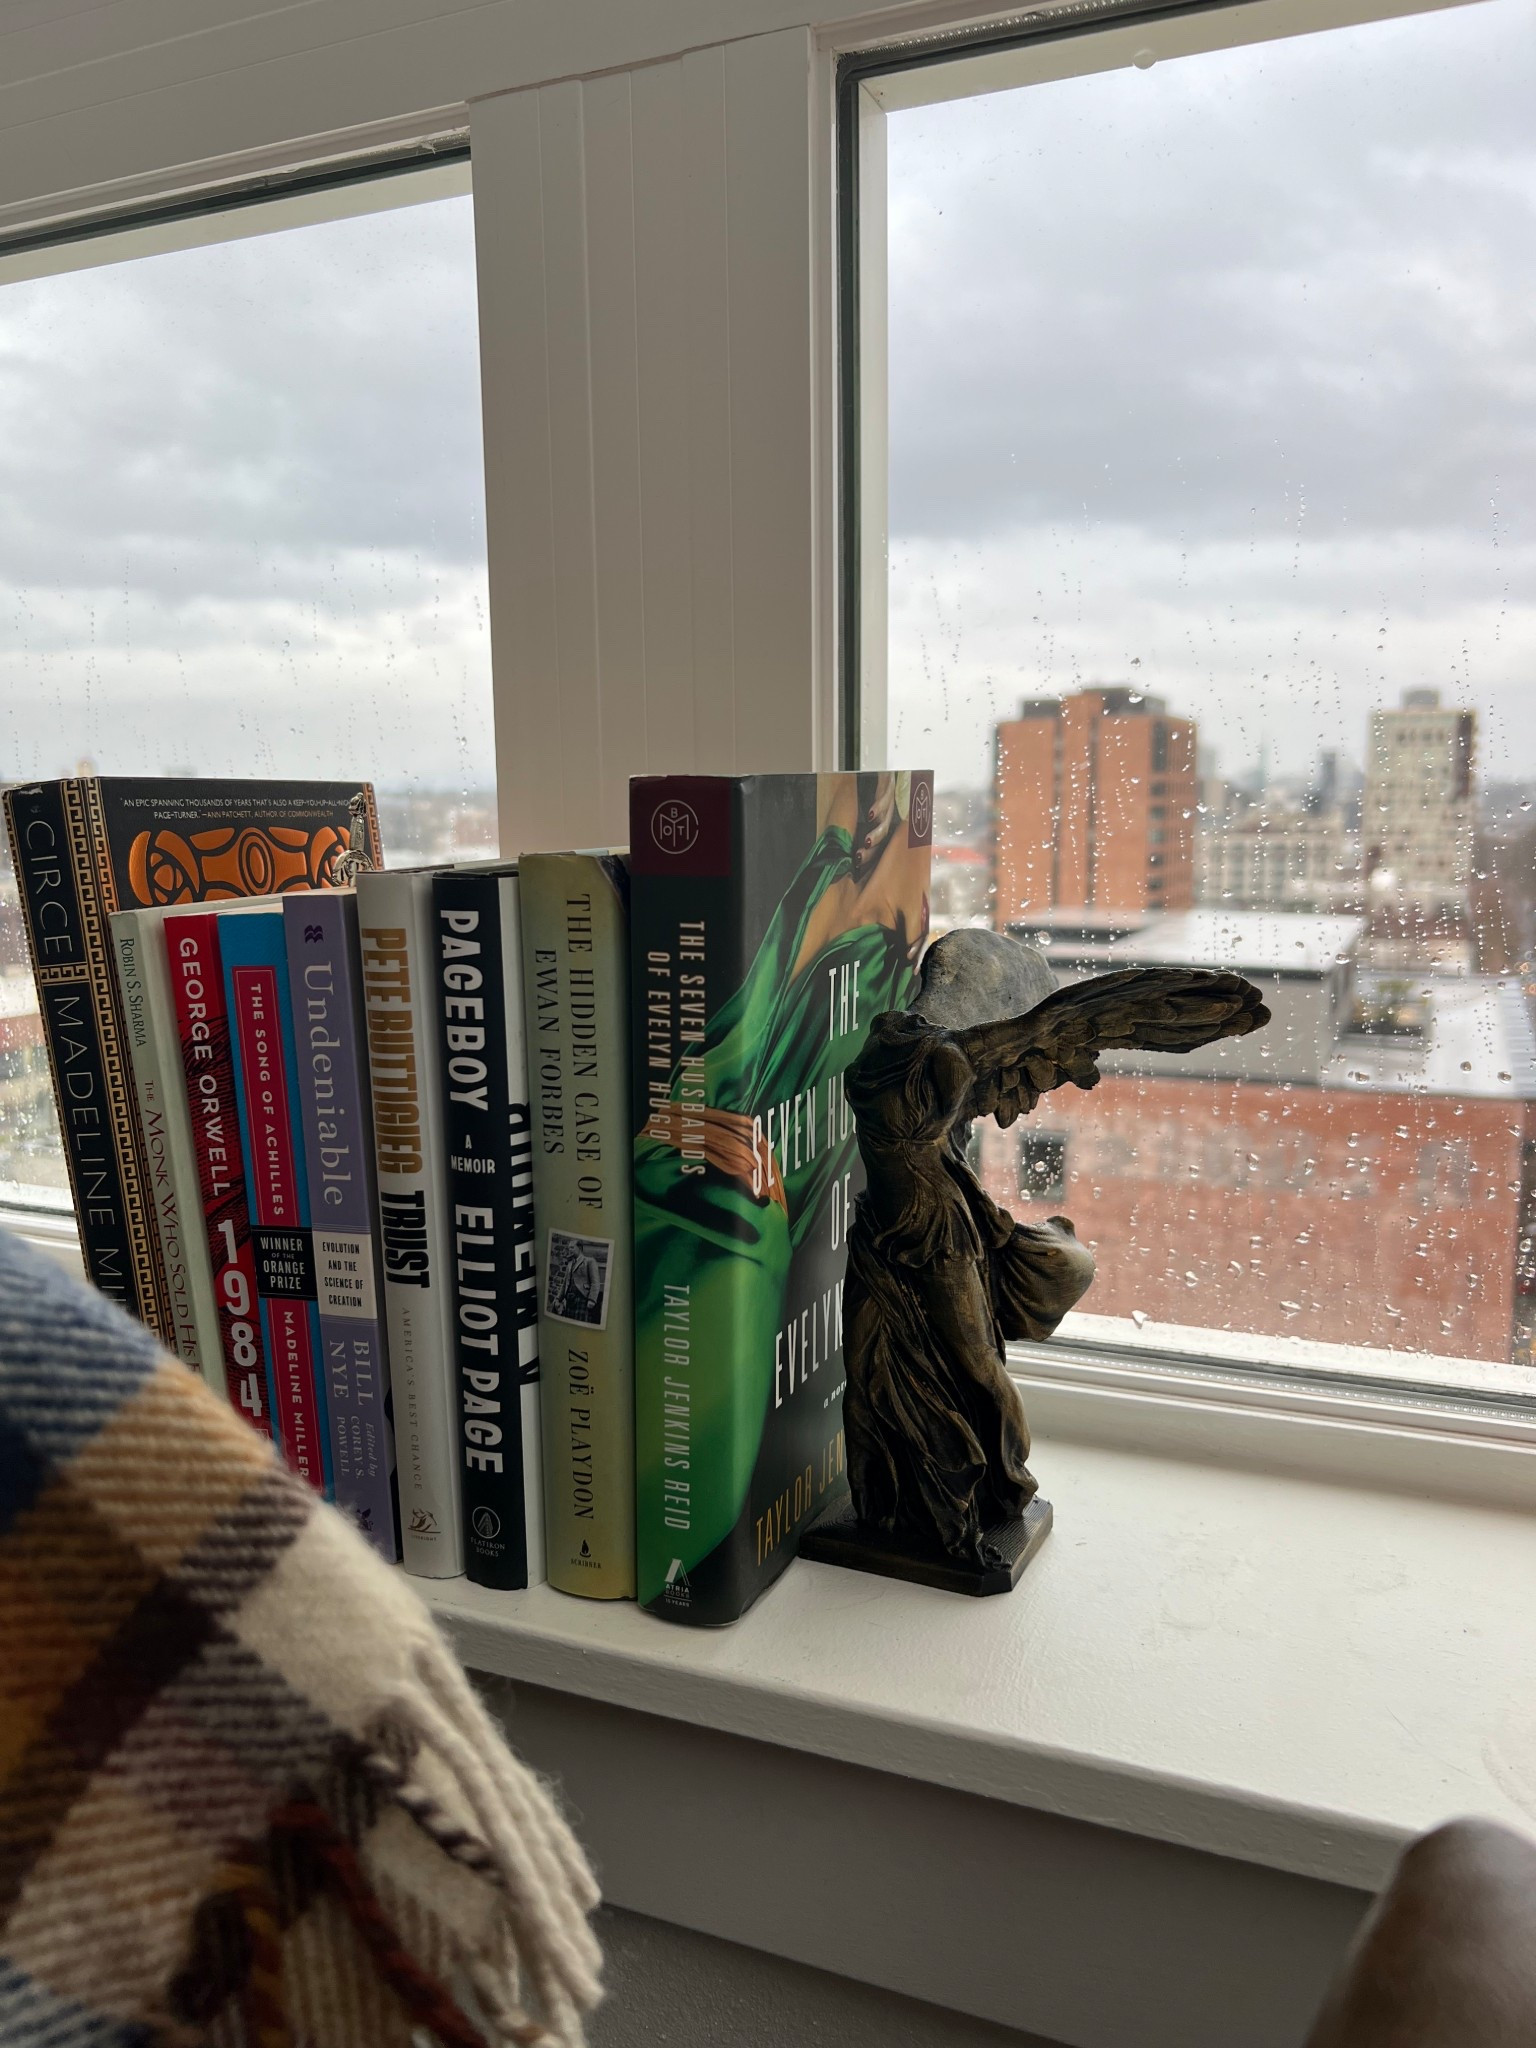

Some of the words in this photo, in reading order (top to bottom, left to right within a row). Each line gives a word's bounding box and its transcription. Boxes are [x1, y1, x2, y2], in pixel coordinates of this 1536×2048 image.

[136, 799, 150, 807] EPIC
[151, 799, 185, 807] SPANNING
[186, 799, 224, 807] THOUSANDS
[225, 799, 233, 807] OF
[234, 799, 252, 807] YEARS
[253, 799, 272, 807] THAT'S
[273, 799, 287, 807] ALSO
[255, 810, 278, 818] AUTHOR
[279, 810, 287, 818] OF
[288, 809, 334, 818] COMMONWEALTH
[26, 820, 73, 955] CIRCE
[566, 893, 592, 953] THE
[679, 921, 705, 961] THE
[120, 937, 137, 977] ROBIN
[361, 928, 412, 1003] PETE
[647, 951, 671, 978] OF
[126, 981, 142, 994] S.
[251, 983, 264, 1020] THE
[440, 909, 489, 1112] PAGEBOY
[535, 948, 560, 1034] EWAN
[679, 973, 706, 1043] SEVEN
[829, 960, 861, 1041] THE
[129, 995, 147, 1048] SHARMA
[569, 967, 599, 1079] HIDDEN
[647, 990, 671, 1069] EVELYN
[179, 937, 213, 1060] GEORGE
[199, 1074, 231, 1197] ORWELL
[256, 1029, 271, 1082] SONG
[304, 961, 352, 1205] Undeniable
[54, 996, 115, 1226] MADELINE
[262, 1090, 275, 1115] OF
[367, 1009, 423, 1174] BUTTIGIEG
[539, 1047, 565, 1156] FORBES
[648, 1081, 672, 1141] HUGO
[680, 1055, 706, 1176] HUSBANDS
[146, 1108, 169, 1188] MONK
[465, 1134, 473, 1149] A
[574, 1091, 601, 1162] CASE
[752, 1086, 816, 1198] SEVEN
[827, 1071, 857, 1150] HU
[265, 1124, 284, 1216] ACHILLES
[450, 1154, 496, 1175] MEMOIR
[577, 1176, 603, 1210] OF
[161, 1192, 181, 1259] WHO
[380, 1189, 431, 1289] TRUST
[831, 1171, 850, 1251] OF
[260, 1237, 304, 1252] WINNER
[263, 1260, 306, 1275] ORANGE
[322, 1241, 361, 1255] EVOLUTION
[328, 1260, 342, 1271] AND
[344, 1260, 358, 1272] THE
[170, 1263, 189, 1319] SOLD
[270, 1275, 302, 1290] PRIZE
[324, 1276, 353, 1289] SCIENCE
[355, 1279, 364, 1290] OF
[328, 1294, 362, 1307] CREATION
[455, 1204, 499, 1357] ELLIOT
[218, 1219, 263, 1417] 1984
[402, 1307, 415, 1387] AMERICA'S
[664, 1285, 690, 1367] TAYLOR
[775, 1279, 843, 1410] EVELYN
[284, 1311, 302, 1404] MADELINE
[294, 1412, 310, 1477] MILLER
[329, 1340, 349, 1399] NYE
[353, 1340, 374, 1406] BILL
[568, 1348, 595, 1398] ZOË
[408, 1393, 418, 1427] BEST
[462, 1366, 504, 1473] PAGE
[664, 1376, 690, 1470] JENKINS
[336, 1416, 350, 1476] POWELL
[351, 1415, 364, 1466] COREY
[365, 1422, 377, 1462] Edited
[368, 1463, 378, 1478] by
[411, 1434, 423, 1490] CHANCE
[570, 1407, 594, 1521] PLAYDON
[356, 1467, 365, 1478] S.
[664, 1479, 690, 1531] REID
[756, 1465, 813, 1567] TAYLOR
[470, 1536, 506, 1550] FLATIRON
[476, 1546, 500, 1557] BOOKS
[570, 1558, 602, 1569] SCRIBNER
[665, 1583, 690, 1593] ATRIA
